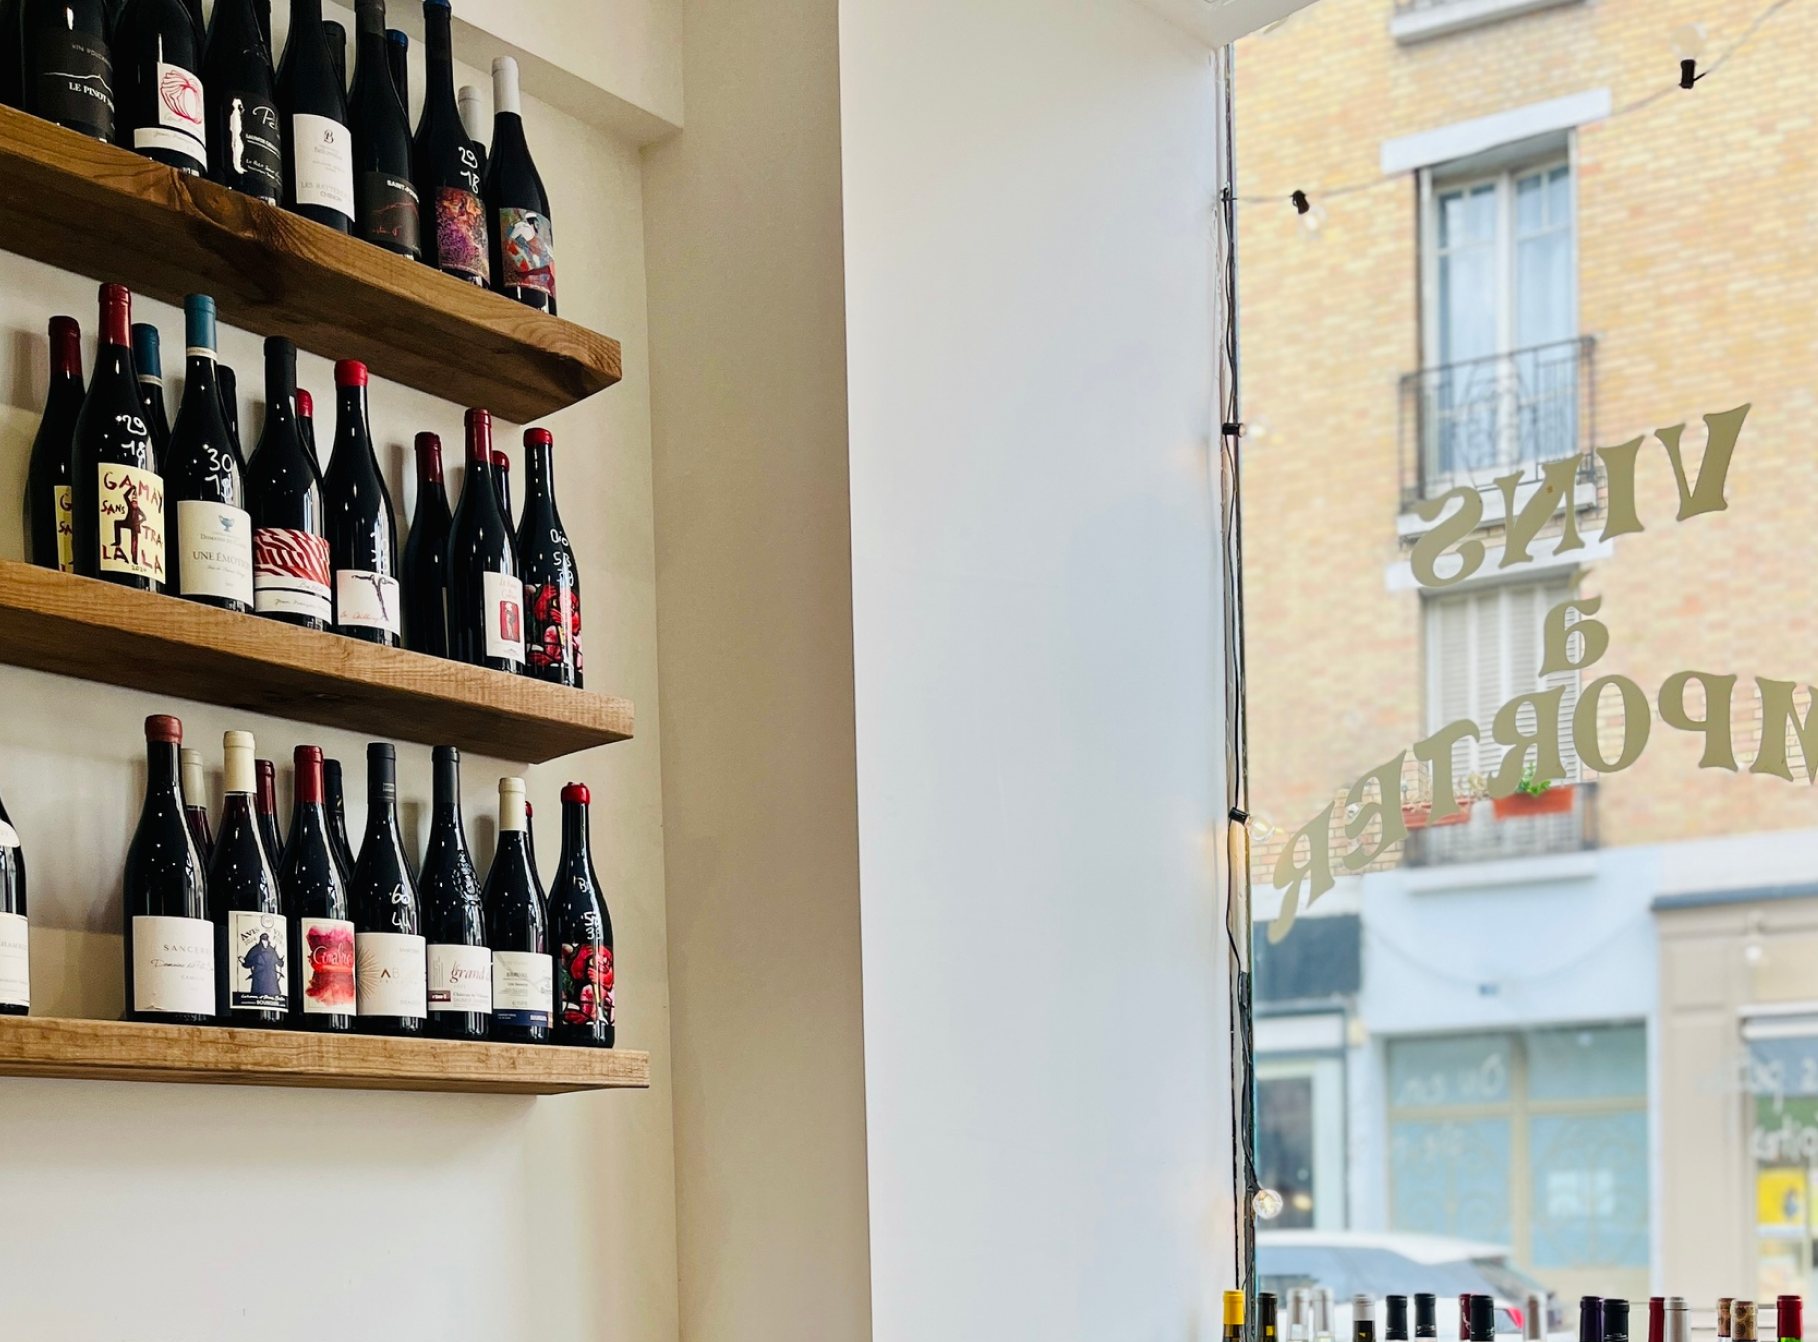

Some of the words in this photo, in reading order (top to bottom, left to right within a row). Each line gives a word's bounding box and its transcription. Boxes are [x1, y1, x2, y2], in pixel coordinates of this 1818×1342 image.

[68, 81, 82, 92] LE
[83, 84, 107, 103] PINOT
[122, 415, 147, 436] 29
[206, 448, 233, 472] 30
[103, 471, 163, 514] GAMAY
[100, 500, 126, 515] SANS
[102, 544, 130, 564] LA
[142, 550, 164, 575] LA
[192, 550, 215, 562] UNE
